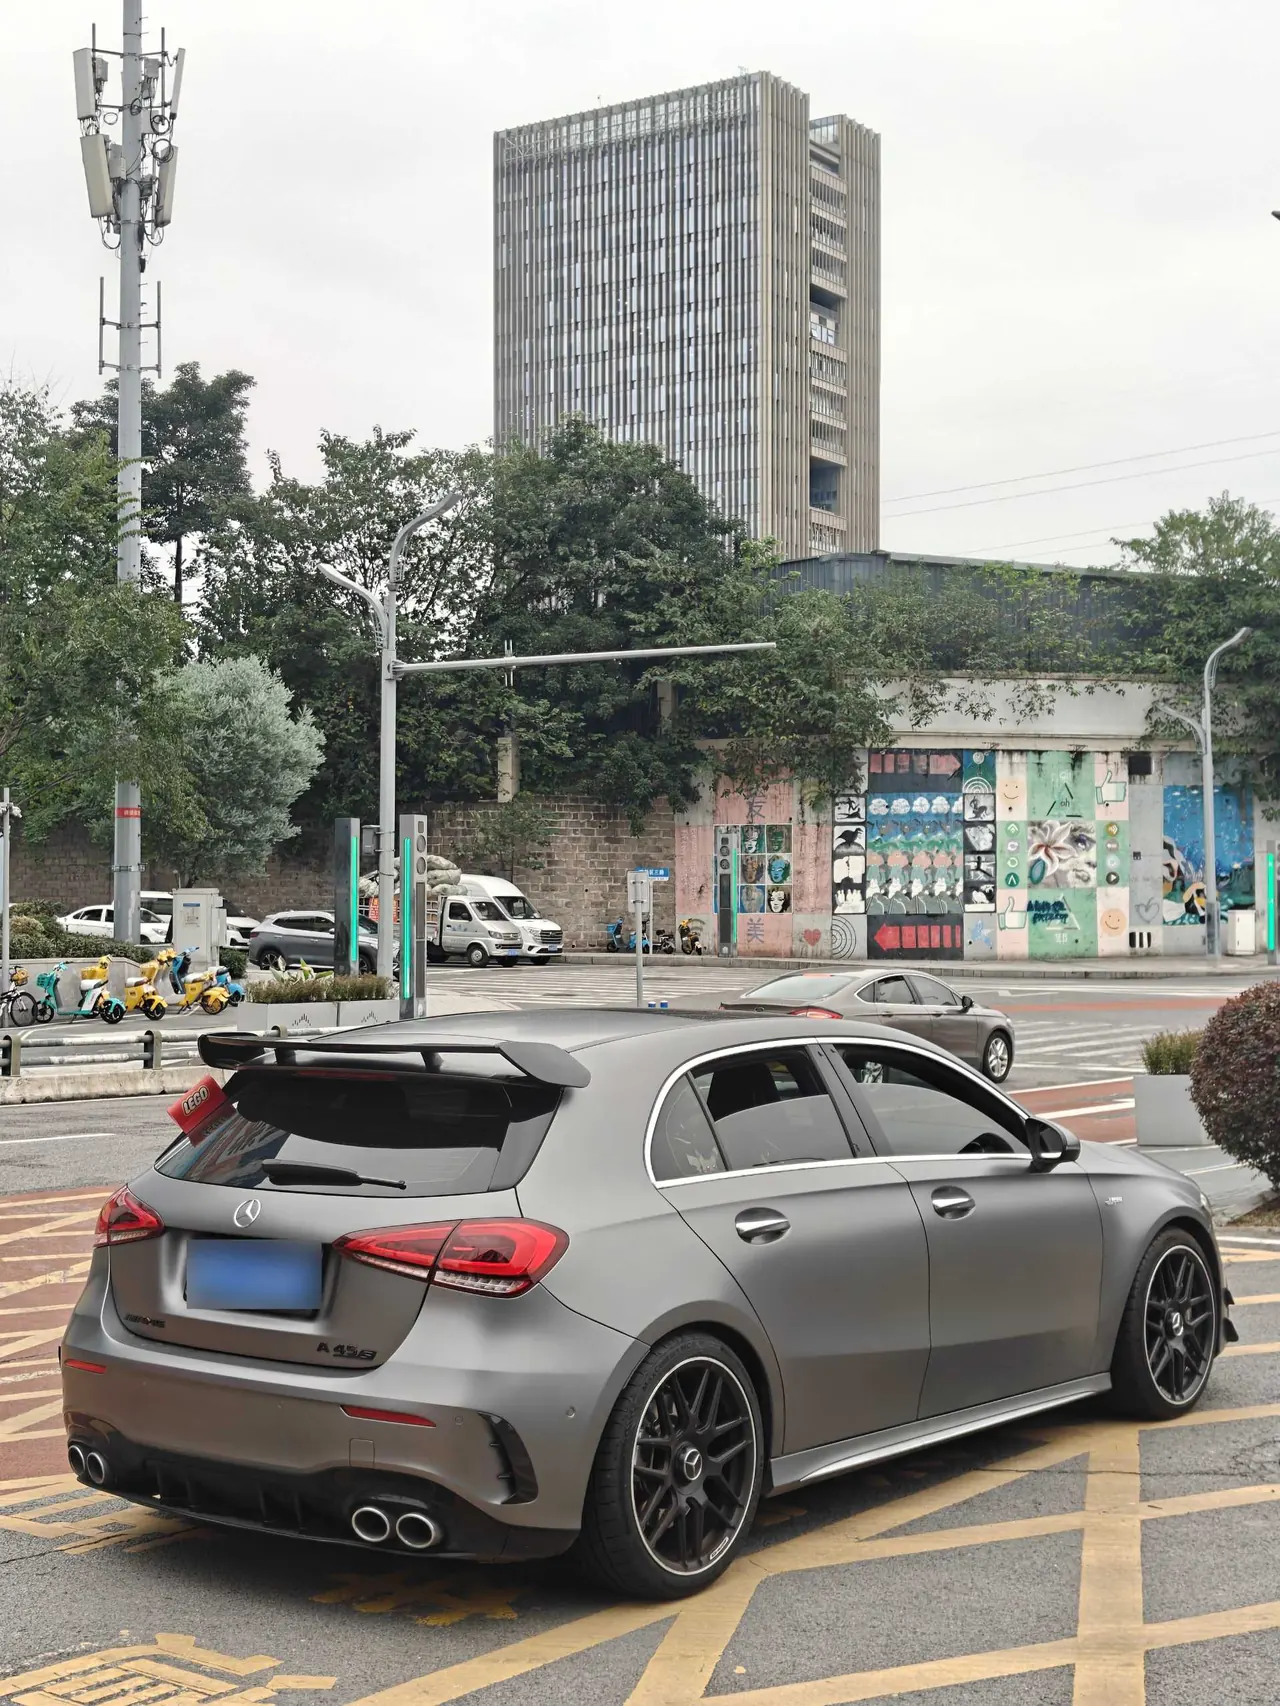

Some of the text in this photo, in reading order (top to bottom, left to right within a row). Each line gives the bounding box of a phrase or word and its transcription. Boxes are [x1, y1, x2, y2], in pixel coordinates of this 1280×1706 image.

[747, 918, 765, 944] 美
[182, 1086, 209, 1115] LEGO
[317, 1342, 329, 1353] A
